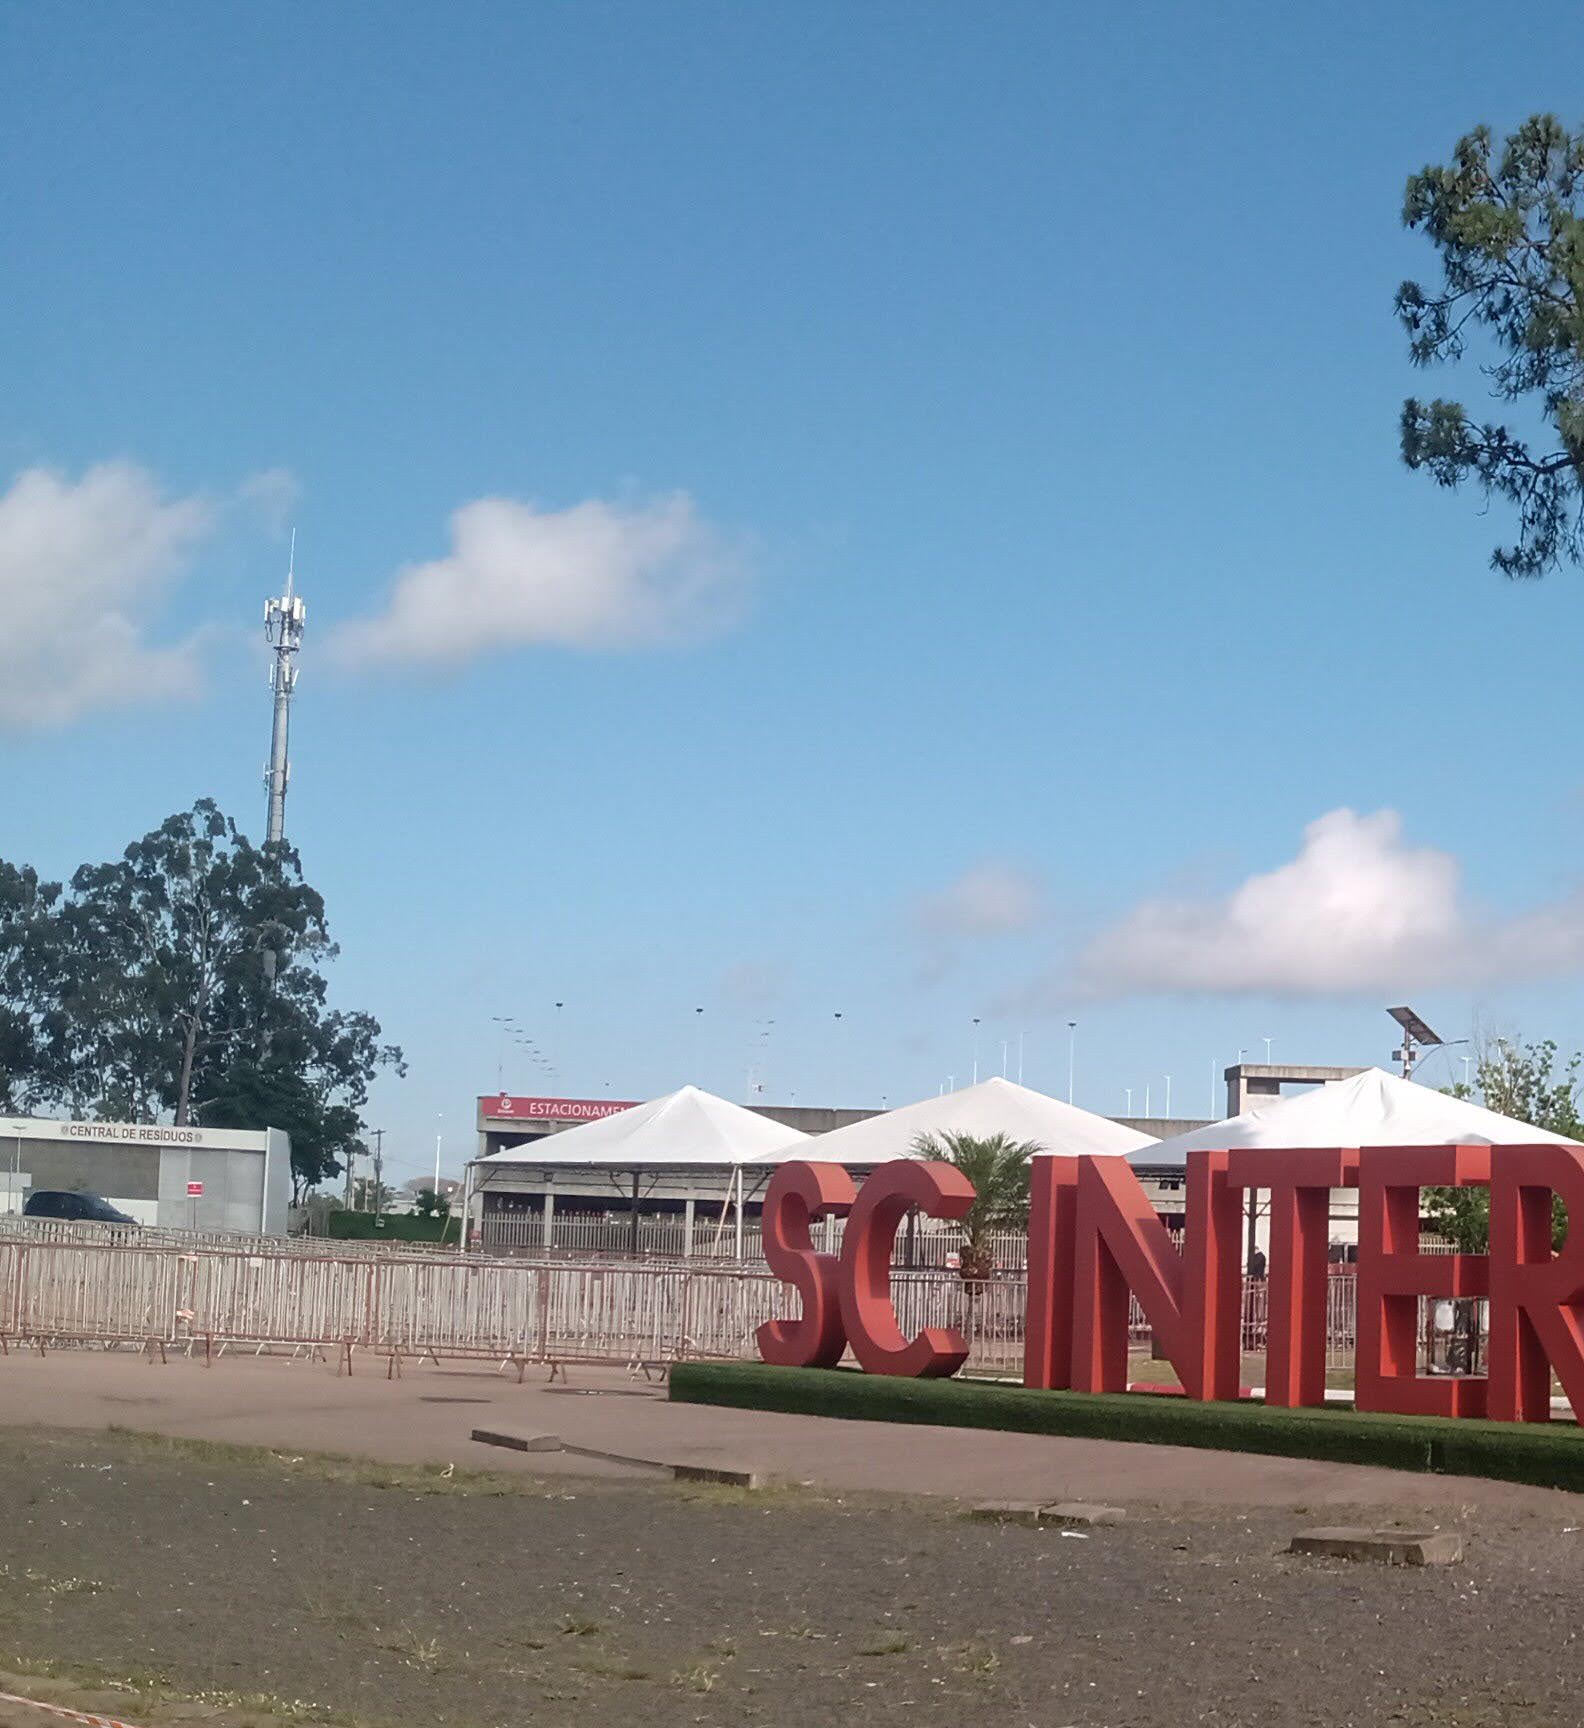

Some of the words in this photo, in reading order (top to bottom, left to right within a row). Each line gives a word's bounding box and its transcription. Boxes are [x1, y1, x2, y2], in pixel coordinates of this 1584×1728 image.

[70, 1125, 119, 1139] CENTRAL
[120, 1128, 136, 1140] DE
[139, 1128, 193, 1143] RESÍDUOS
[755, 1159, 977, 1379] SC
